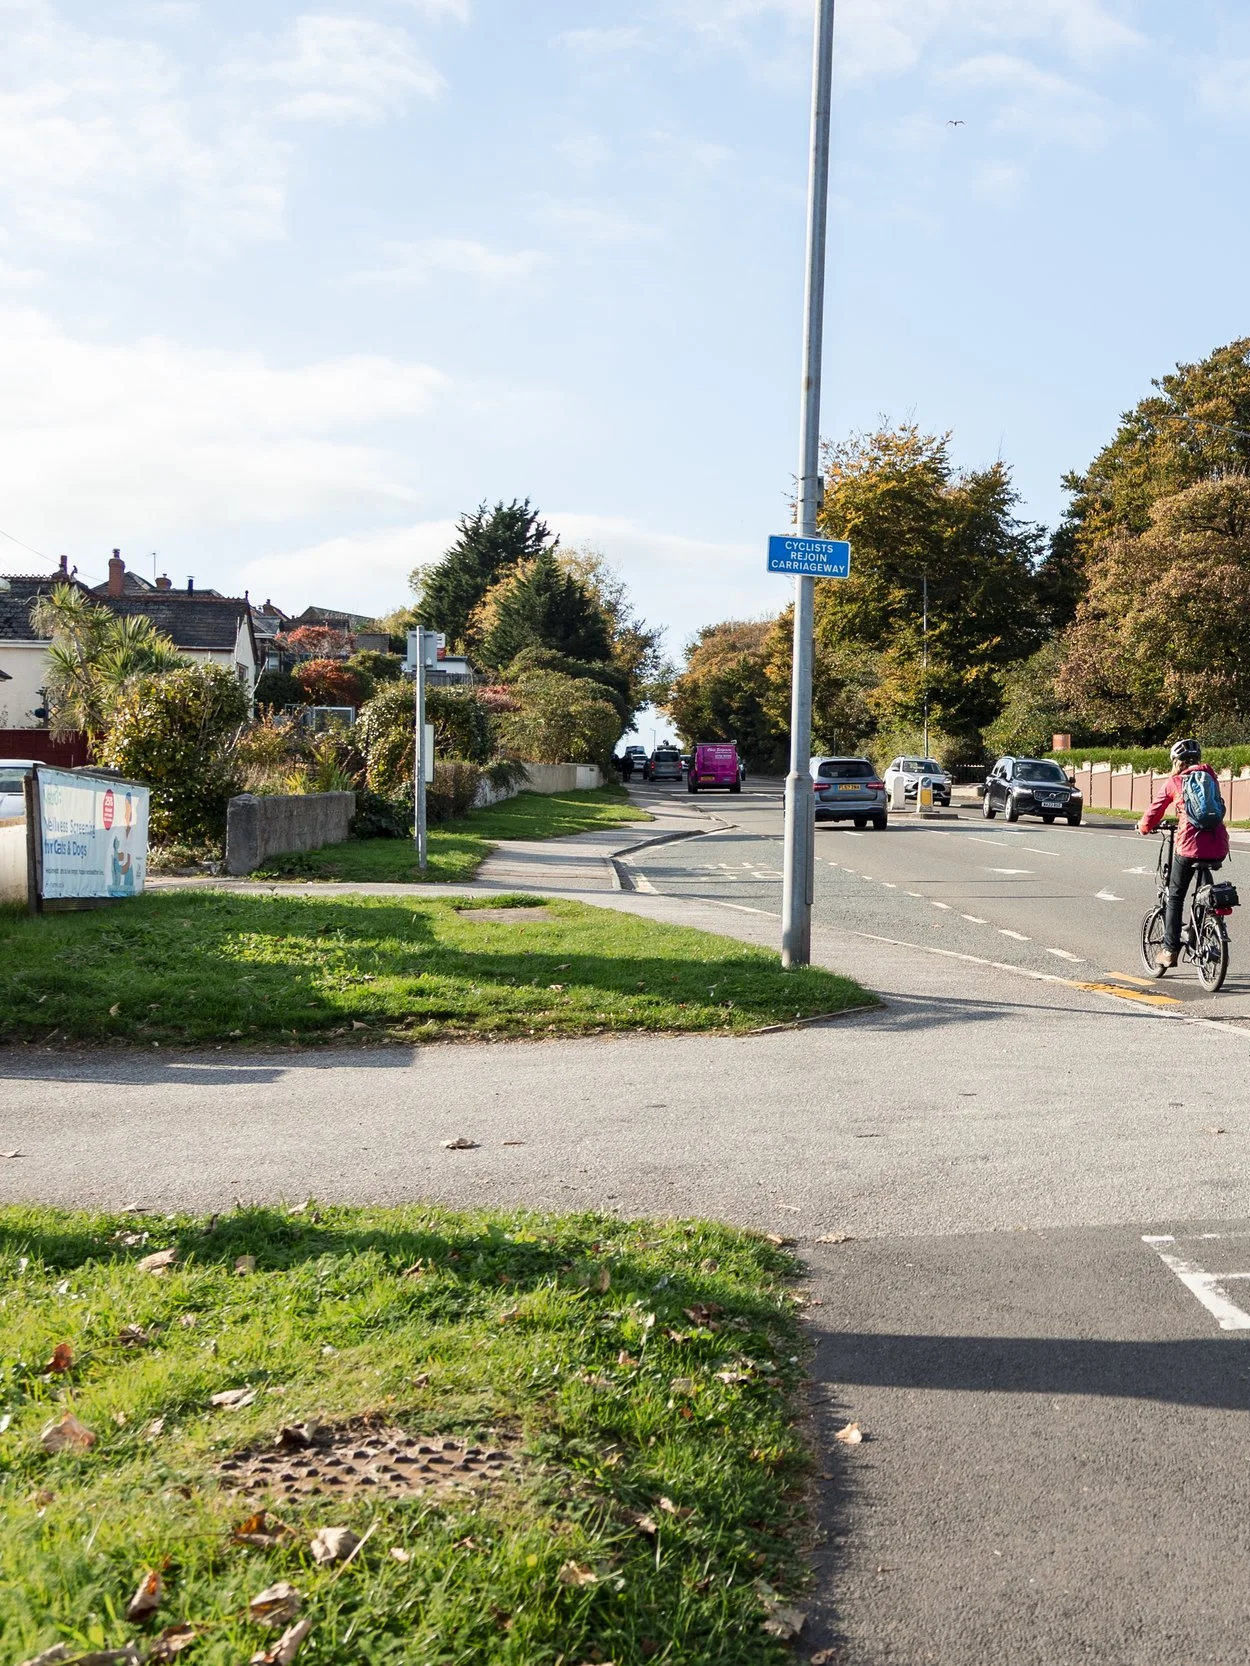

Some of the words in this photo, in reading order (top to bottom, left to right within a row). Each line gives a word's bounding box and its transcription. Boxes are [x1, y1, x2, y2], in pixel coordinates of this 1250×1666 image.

[785, 541, 833, 553] CYCLISTS
[790, 551, 827, 562] REJOIN
[771, 559, 845, 573] CARRIAGEWAY
[54, 839, 66, 855] Cats
[73, 841, 88, 859] Dogs
